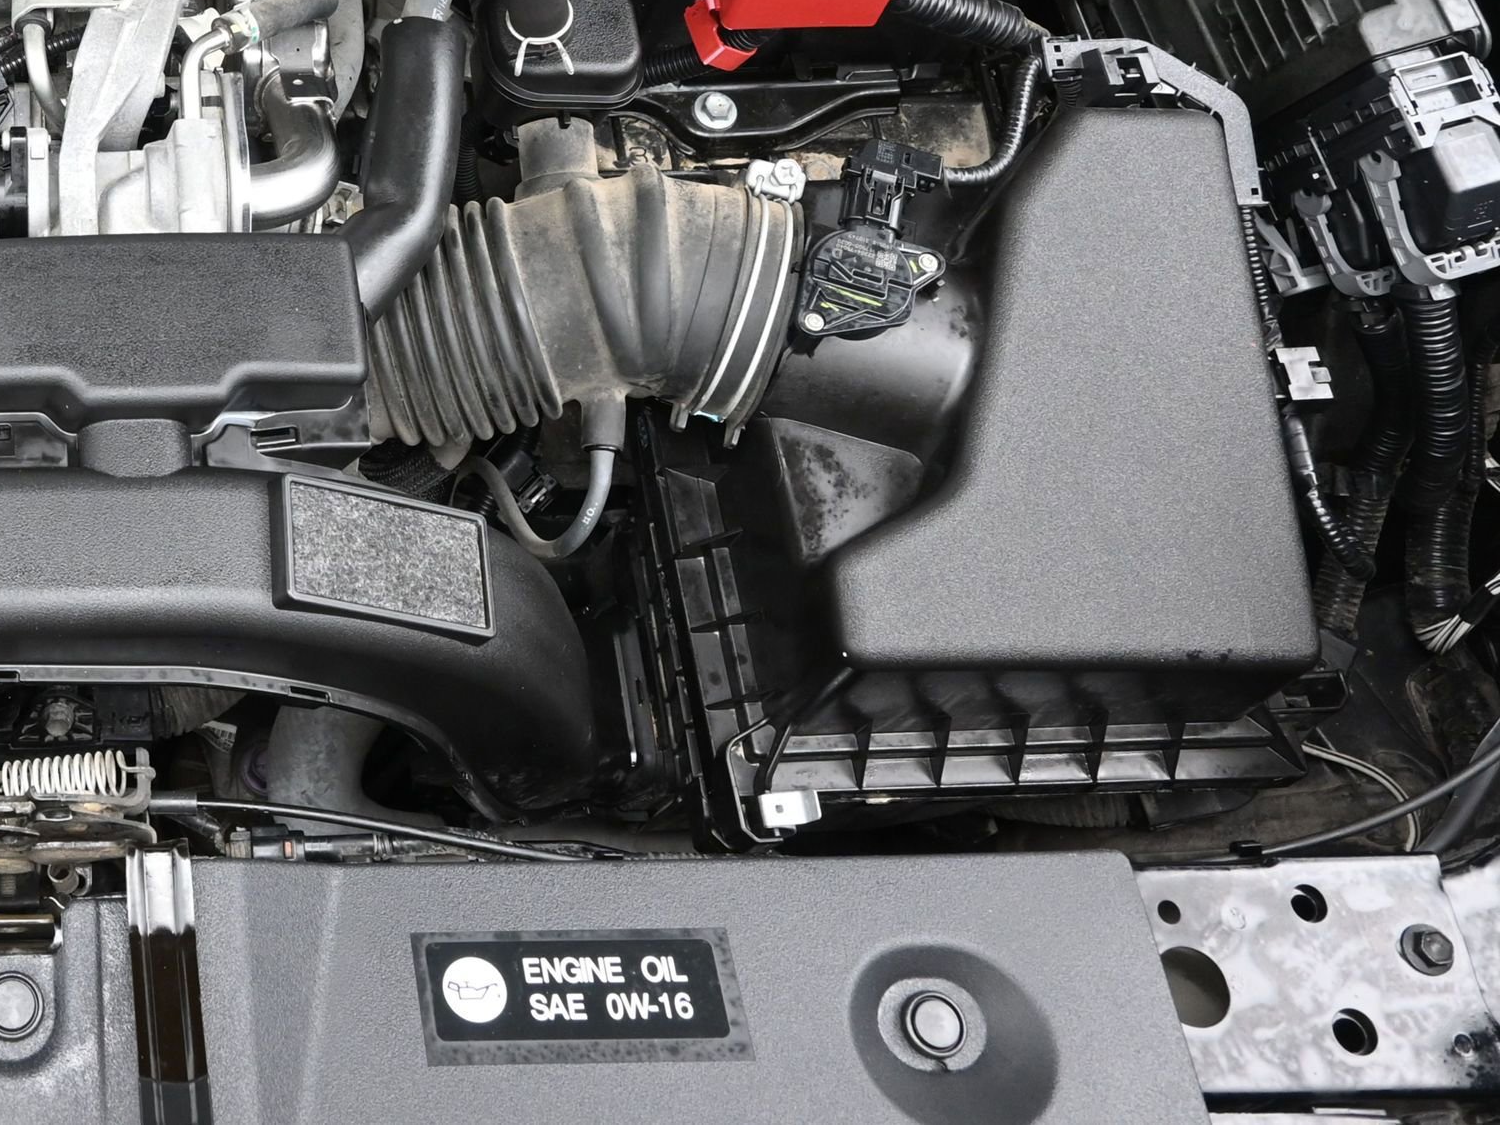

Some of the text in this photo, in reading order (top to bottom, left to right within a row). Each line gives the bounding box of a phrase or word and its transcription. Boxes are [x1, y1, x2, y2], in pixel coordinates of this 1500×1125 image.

[522, 955, 689, 984] ENGINE OIL
[529, 992, 694, 1021] SAE 0W-16
